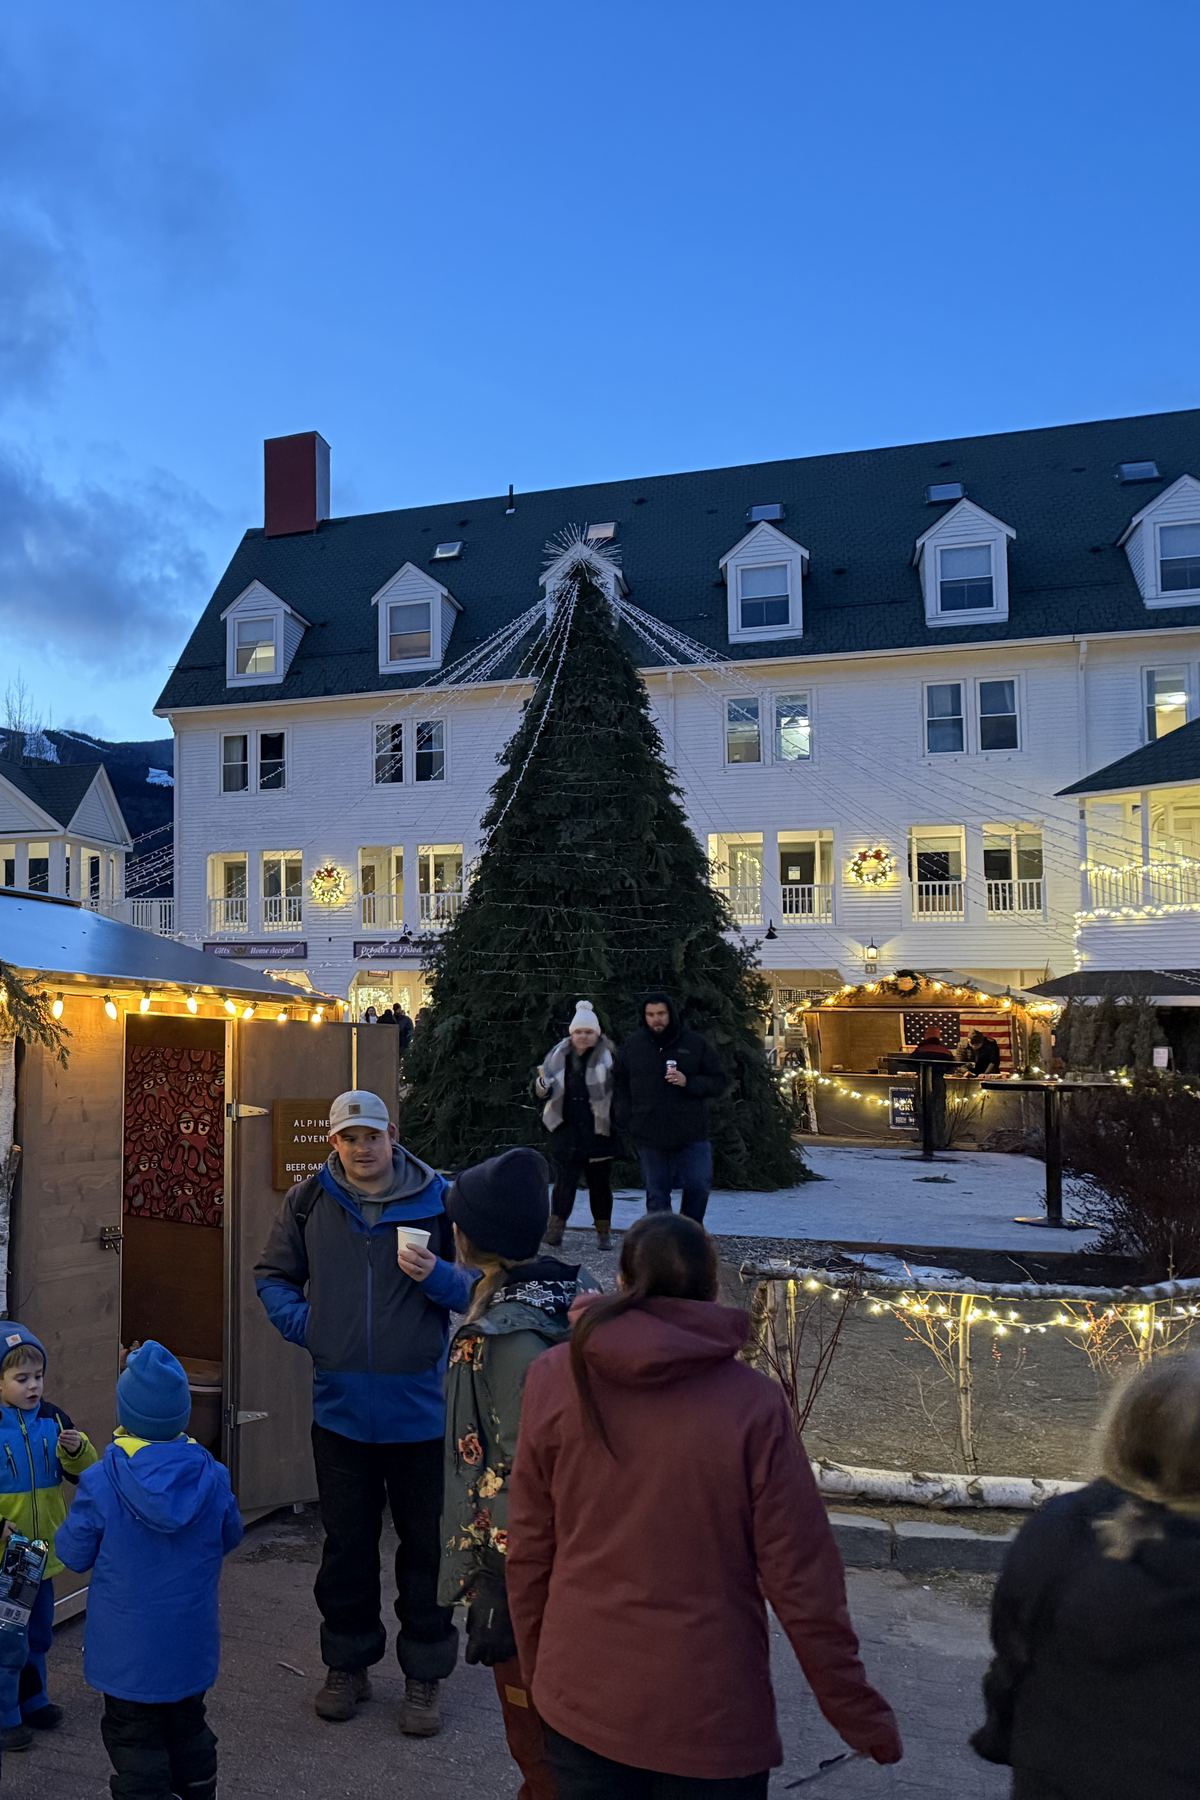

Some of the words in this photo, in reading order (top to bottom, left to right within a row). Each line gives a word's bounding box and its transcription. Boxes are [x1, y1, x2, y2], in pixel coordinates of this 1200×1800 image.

[293, 1119, 330, 1127] ALPINE
[285, 1163, 306, 1171] BEER
[307, 1163, 325, 1171] GAR
[293, 1174, 302, 1182] ID
